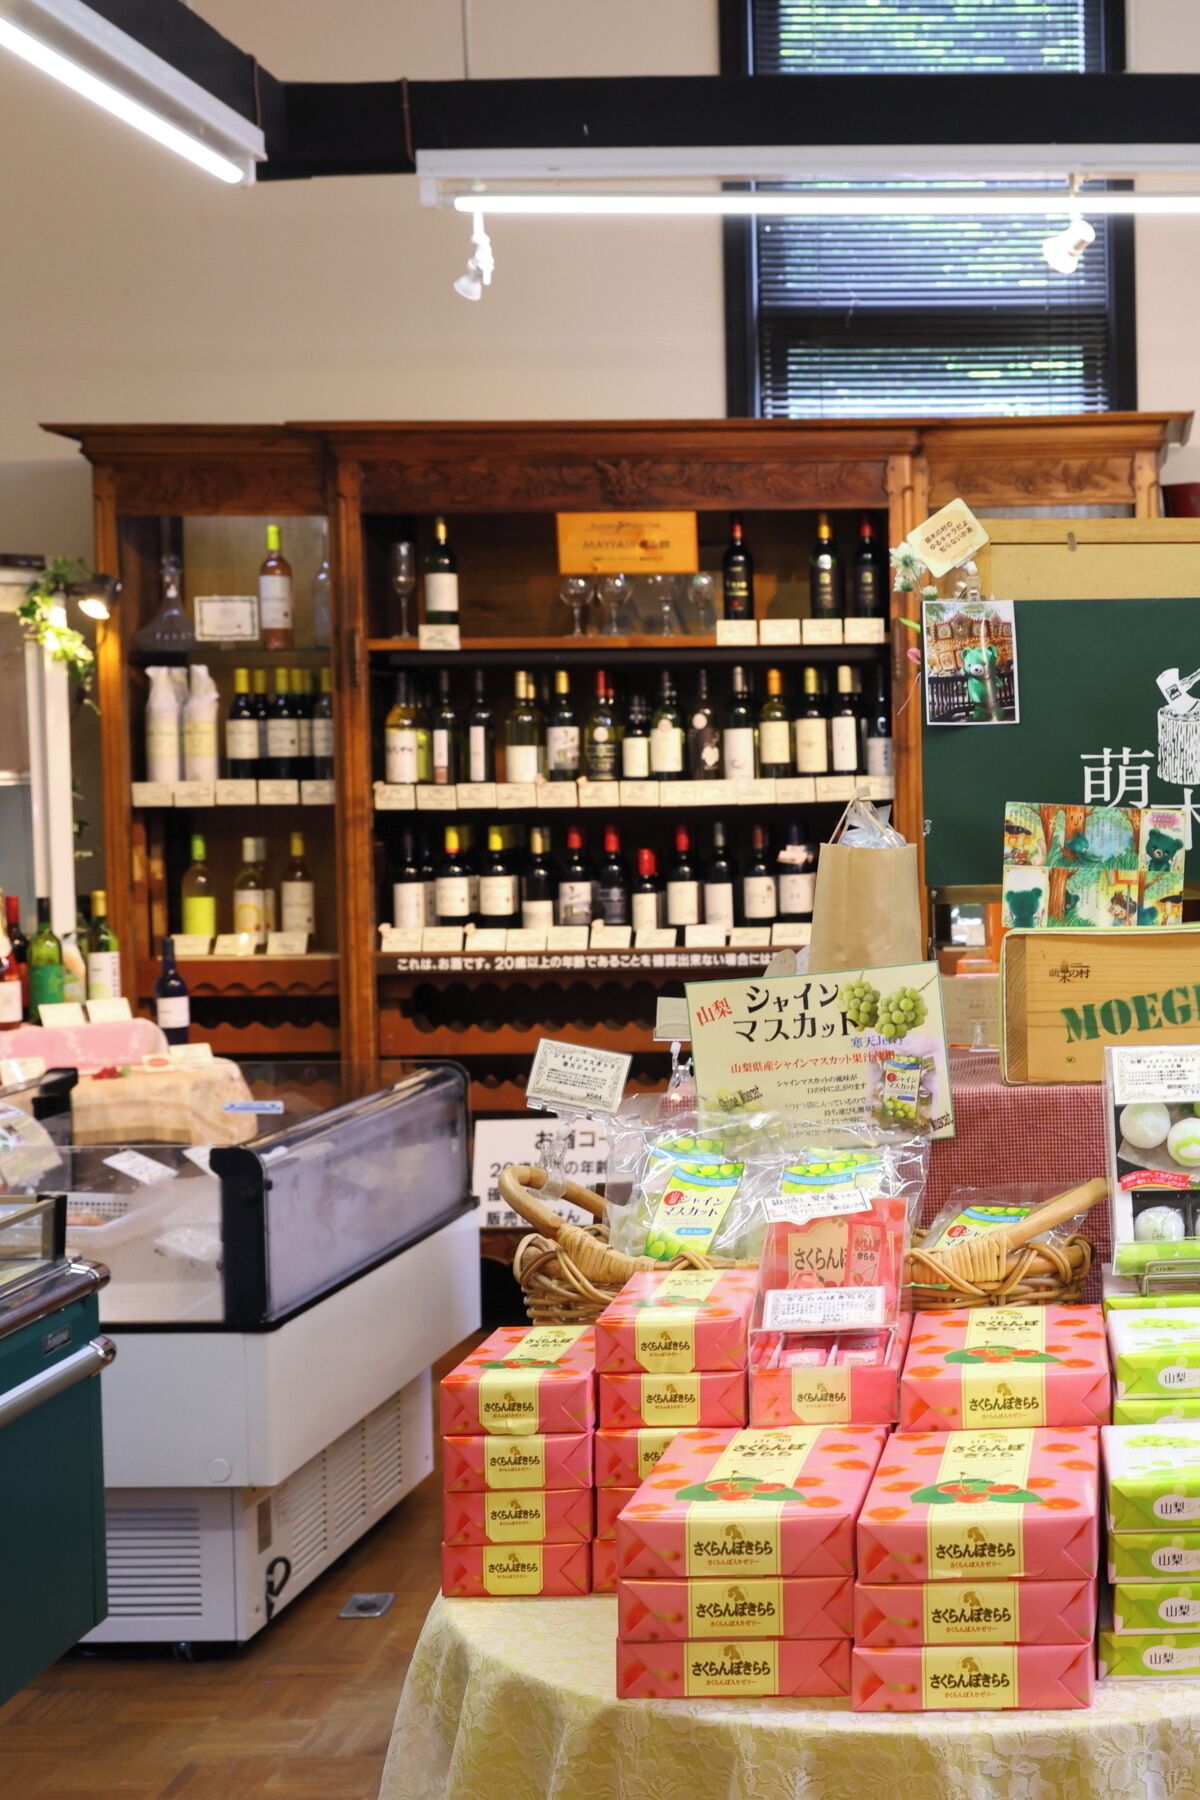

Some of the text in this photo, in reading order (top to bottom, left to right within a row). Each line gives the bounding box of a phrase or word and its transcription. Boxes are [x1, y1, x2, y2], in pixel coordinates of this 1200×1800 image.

[745, 982, 839, 1014] シャイン
[696, 997, 732, 1026] 山梨
[733, 1011, 860, 1042] マスカット
[663, 1206, 719, 1217] マスカット
[640, 1340, 691, 1351] さくらんぼきらら
[646, 1393, 696, 1404] さくらんぼきらら
[797, 1392, 847, 1403] さくらんぼきらら
[969, 1396, 1040, 1412] さくらんぼきらら
[484, 1402, 534, 1413] さくらんぼきらら
[490, 1456, 541, 1467] さくらんぼきらら
[489, 1508, 541, 1521] さくらんぼきらら
[693, 1541, 773, 1556] さくらんぼきらら
[935, 1543, 1016, 1560] さくらんぼきらら
[488, 1561, 539, 1574] さくらんぼきらら
[696, 1601, 776, 1618] さくらんぼきらら
[931, 1607, 1012, 1625] さくらんぼきらら
[691, 1660, 771, 1677] さくらんぼきらら
[930, 1672, 1010, 1689] さくらんぼきらら
